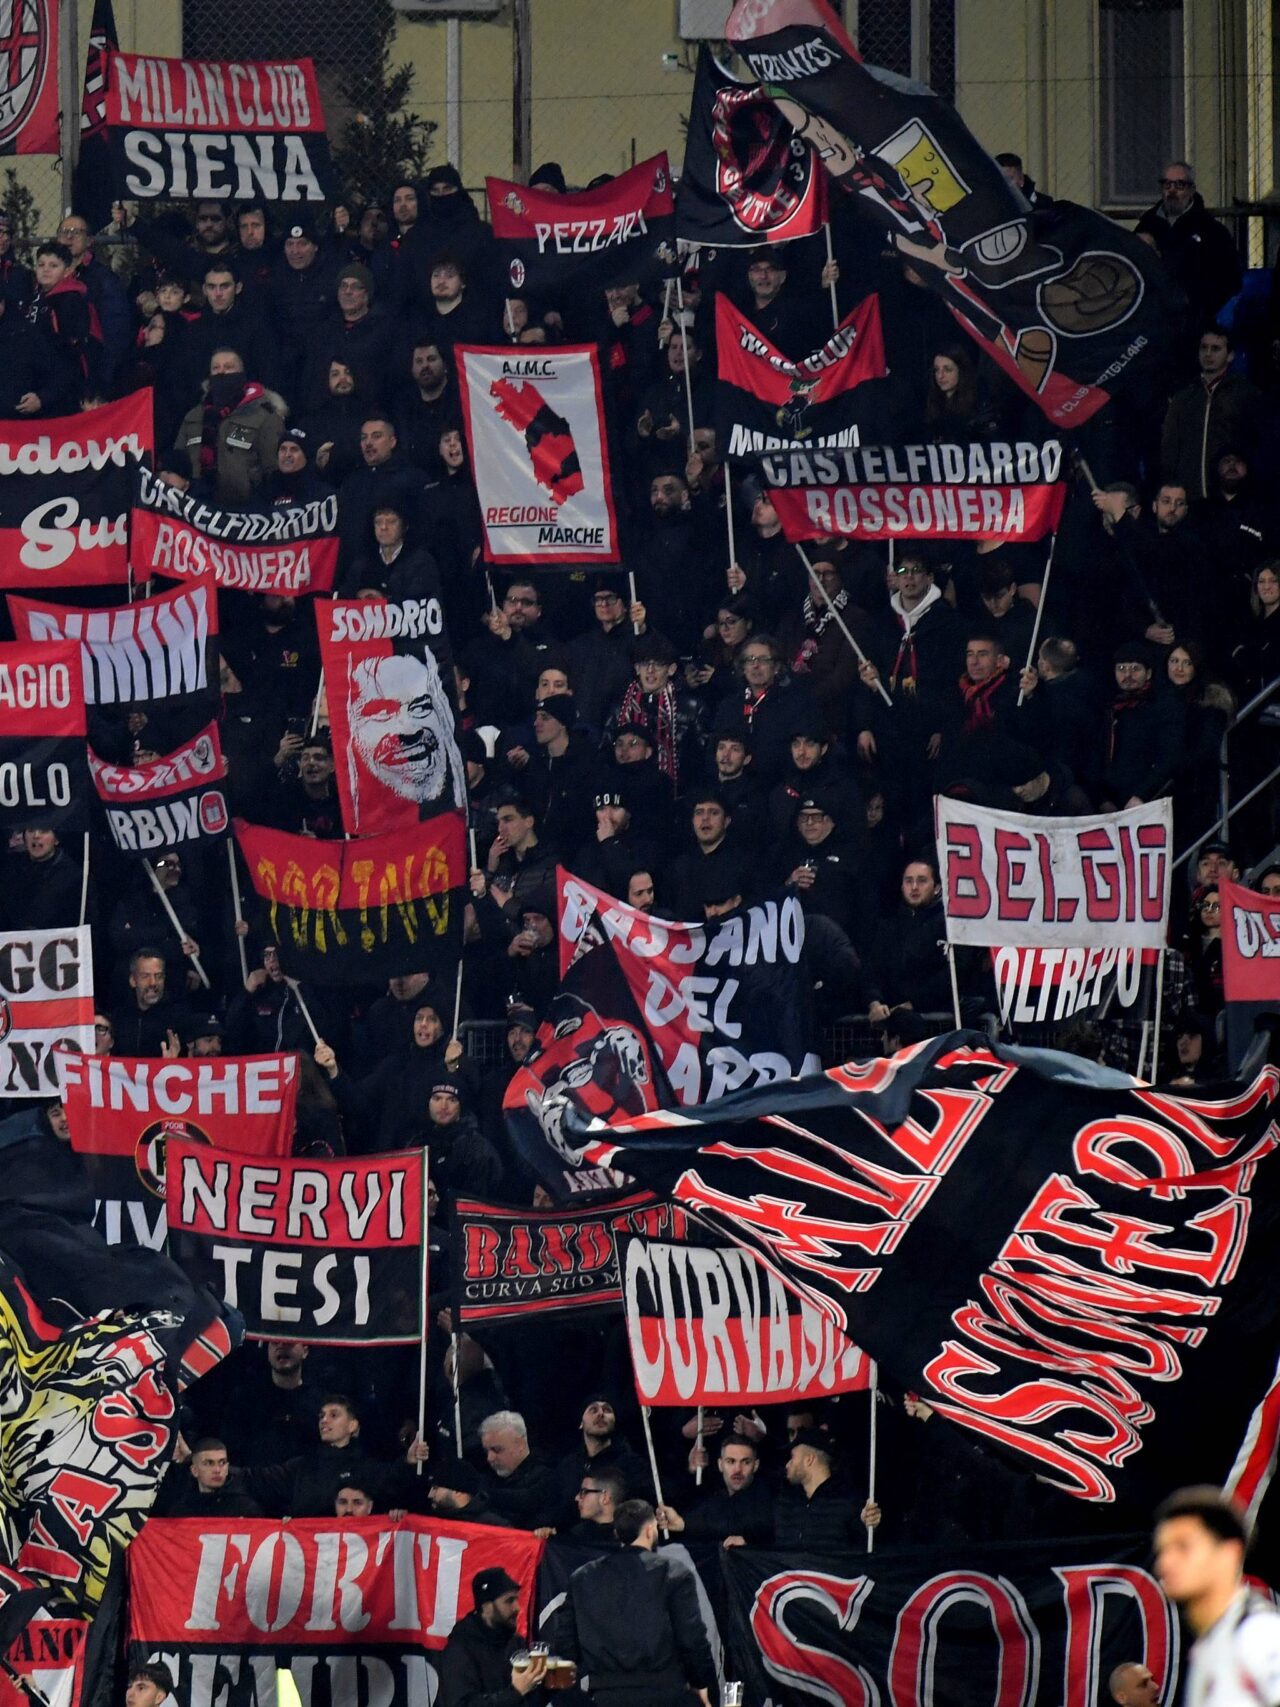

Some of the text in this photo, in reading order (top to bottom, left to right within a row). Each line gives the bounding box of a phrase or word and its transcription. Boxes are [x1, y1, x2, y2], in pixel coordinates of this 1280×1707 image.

[115, 56, 229, 127] MILAN
[229, 63, 312, 129] CLUB
[124, 130, 325, 201] SIENA
[723, 166, 796, 223] GENTILE
[534, 208, 649, 255] PEZZARI
[502, 360, 557, 376] A.I.M.C.
[803, 326, 858, 373] CLUB
[762, 440, 1063, 488] CASTELFIDARDO
[138, 466, 339, 544] CASTELFIDARDO
[486, 506, 558, 525] REGIONE
[538, 526, 604, 546] MARCHE
[805, 486, 1025, 535] ROSSONERA
[151, 522, 312, 591] ROSSONERA
[945, 821, 1168, 924] BELGIO
[644, 969, 743, 1039] DEL
[180, 1156, 407, 1241] NERVI
[211, 1244, 372, 1326] TESI
[465, 1281, 542, 1299] CURVA
[625, 1236, 795, 1400] CURVA
[183, 1531, 469, 1638] FORTI
